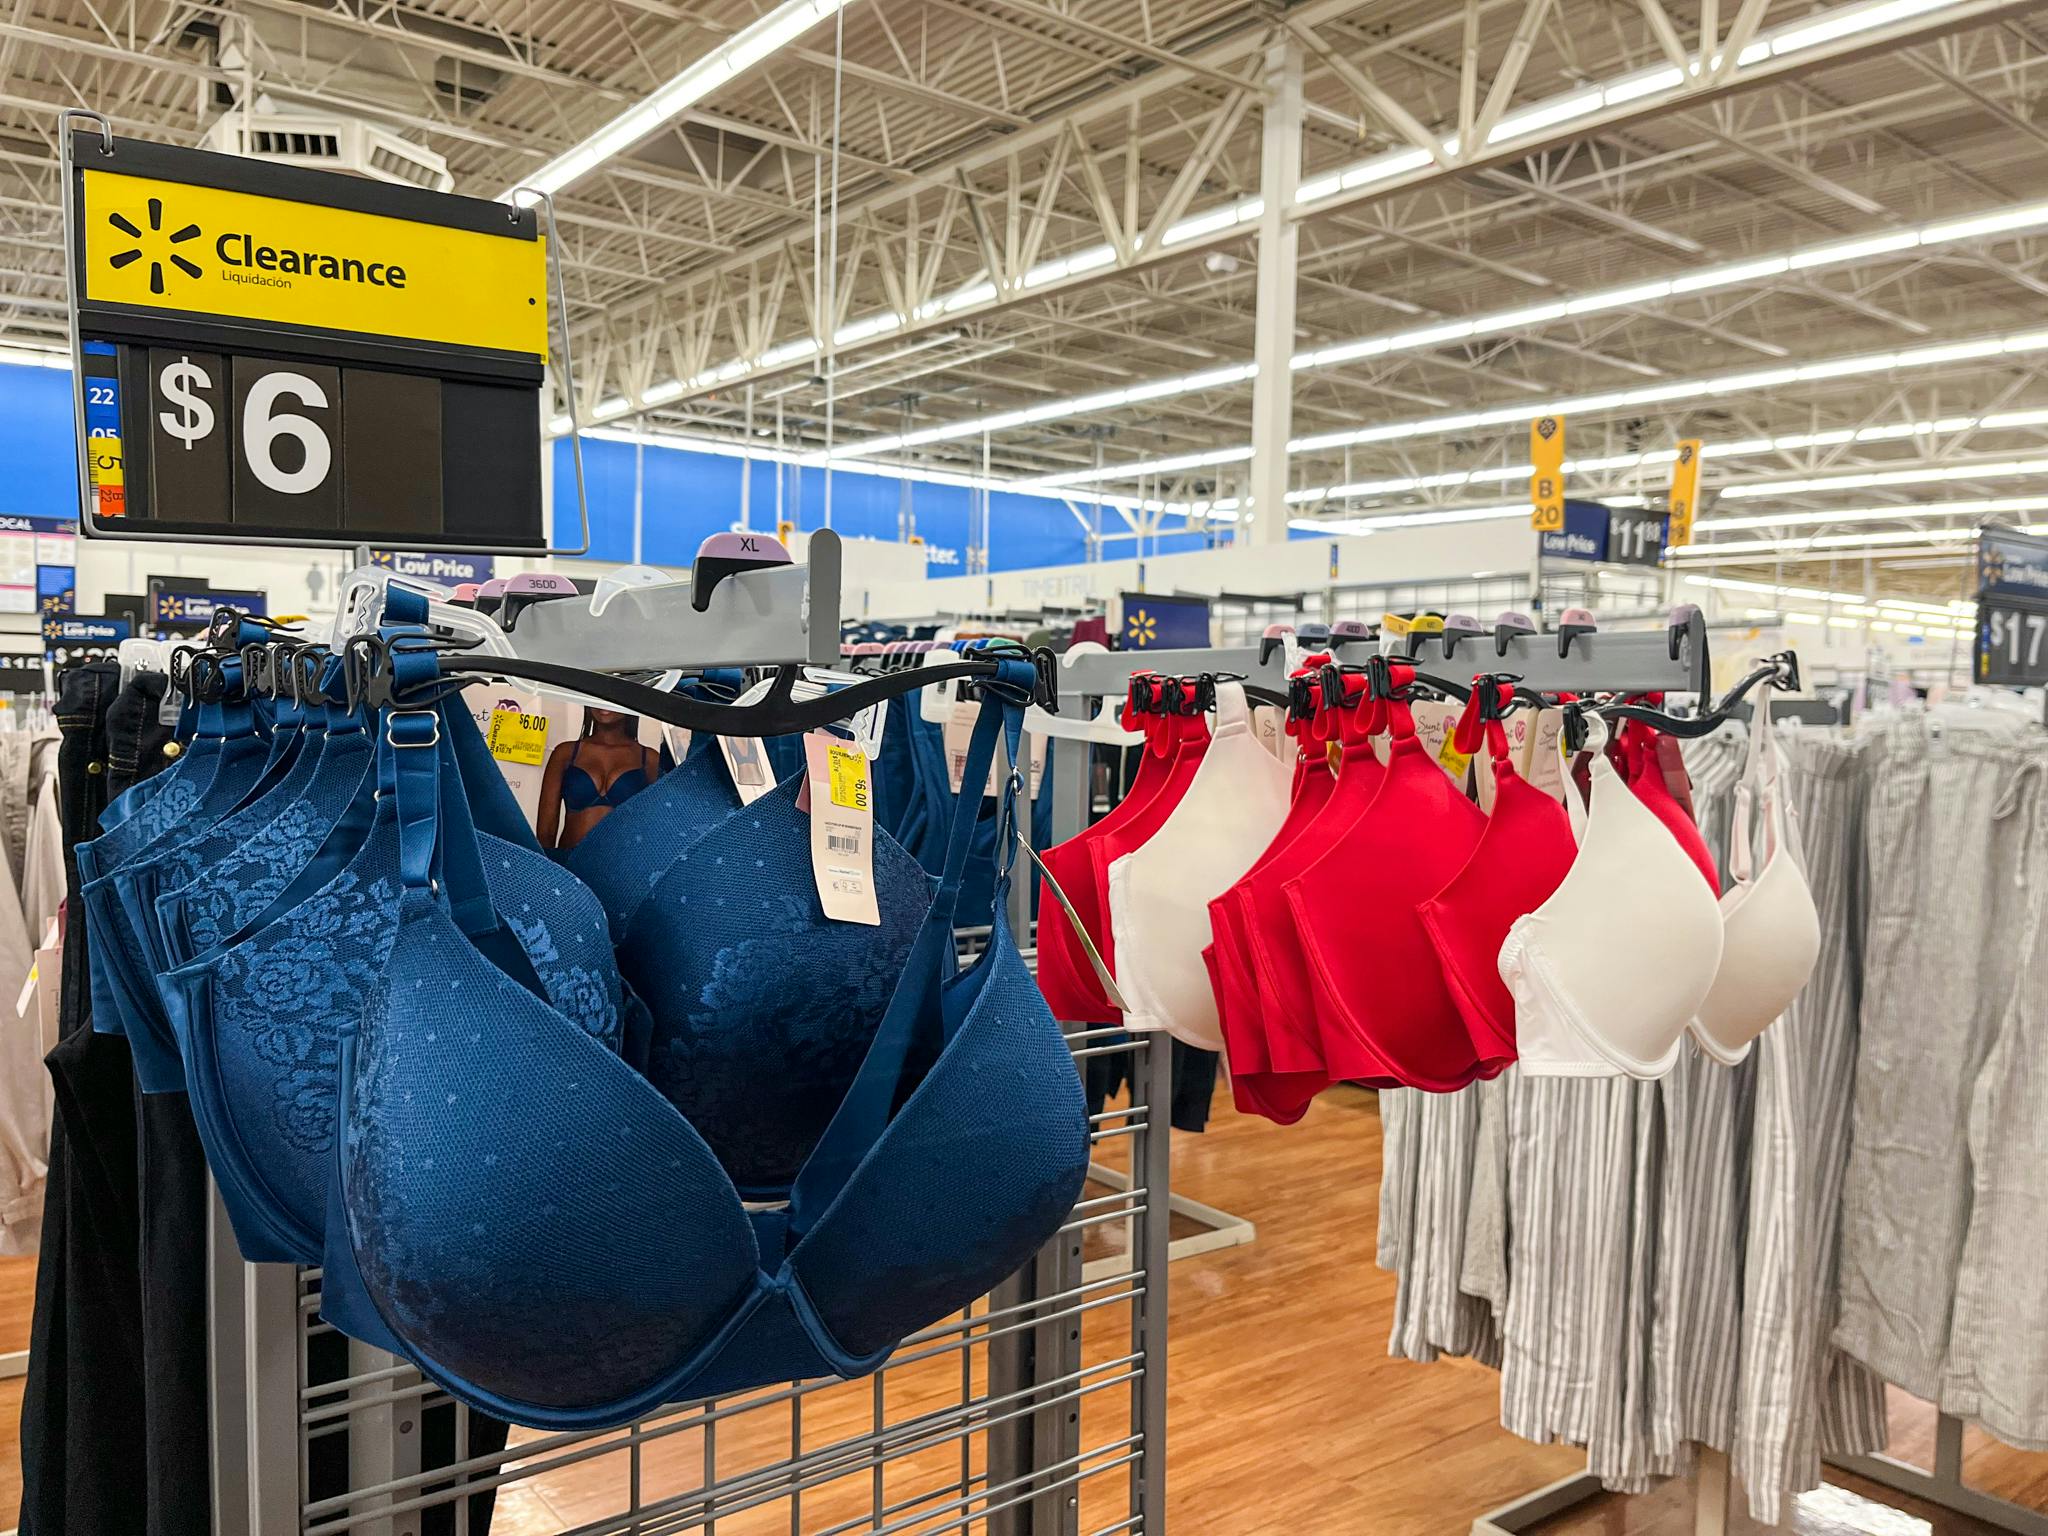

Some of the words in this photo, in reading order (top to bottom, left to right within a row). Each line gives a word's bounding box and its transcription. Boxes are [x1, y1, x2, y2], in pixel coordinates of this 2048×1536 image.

[216, 233, 407, 289] Clearance
[222, 269, 292, 289] Liquidación
[89, 387, 115, 405] 22
[1538, 480, 1553, 499] B
[1533, 507, 1560, 526] 20
[740, 537, 760, 552] XL
[394, 553, 431, 577] Low
[432, 559, 475, 579] Price
[519, 713, 546, 732] $6.00
[489, 723, 501, 755] Clearanc
[854, 779, 868, 807] $6.00
